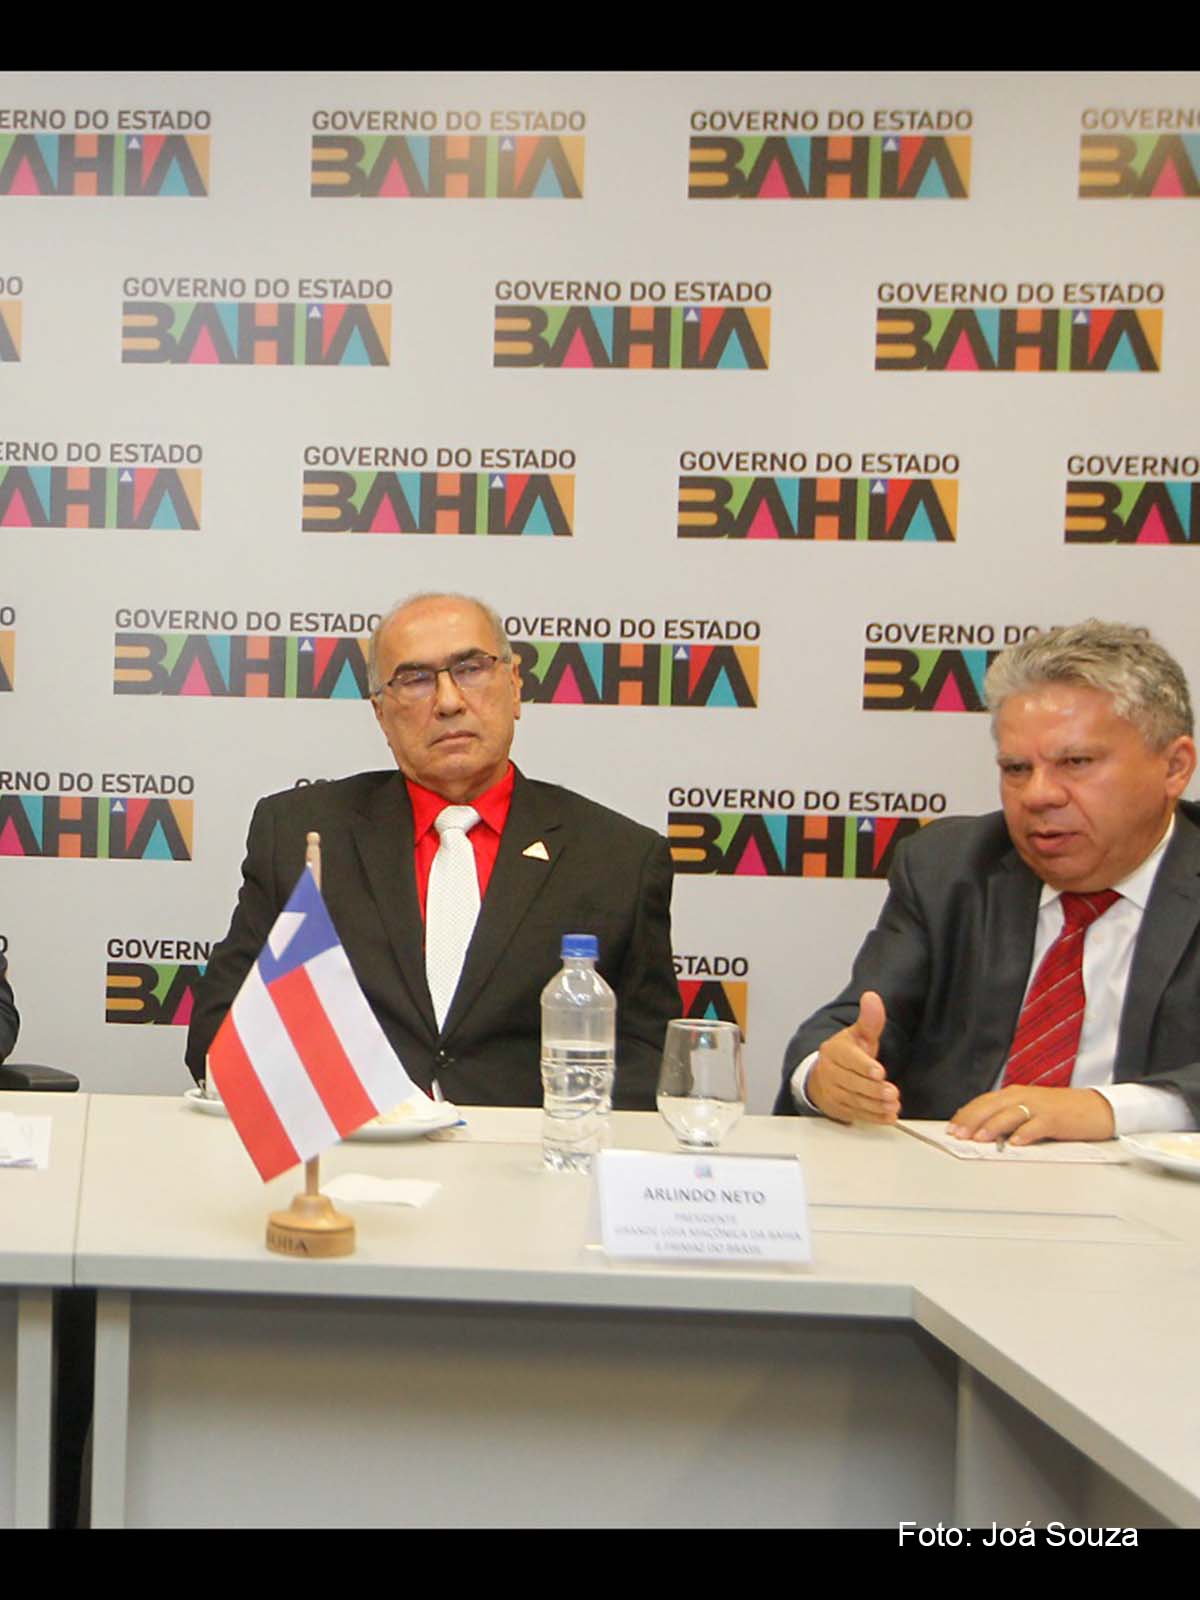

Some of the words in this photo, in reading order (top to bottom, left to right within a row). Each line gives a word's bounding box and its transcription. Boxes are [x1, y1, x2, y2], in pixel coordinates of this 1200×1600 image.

[75, 109, 109, 130] DO
[118, 110, 211, 130] ESTADO
[312, 110, 437, 130] GOVERNO
[446, 111, 480, 130] DO
[491, 111, 586, 131] ESTADO
[691, 110, 818, 131] GOVERNO
[828, 110, 864, 131] DO
[873, 110, 972, 130] ESTADO
[1081, 108, 1200, 130] GOVERN
[312, 136, 584, 198] BAHIA
[689, 135, 972, 200] BAHIA
[123, 277, 246, 298] GOVERNO
[255, 278, 290, 298] DO
[298, 278, 393, 299] ESTADO
[496, 281, 621, 301] GOVERNO
[630, 281, 666, 302] DO
[675, 282, 772, 302] ESTADO
[878, 283, 1007, 303] GOVERNO
[1017, 283, 1054, 303] DO
[1064, 283, 1164, 304] ESTADO
[123, 304, 391, 365] BAHIA
[495, 306, 770, 370] BAHIA
[876, 308, 1163, 373] BAHIA
[67, 443, 101, 462] DO
[110, 443, 202, 464] ESTADO
[304, 447, 428, 468] GOVERNO
[437, 448, 472, 468] DO
[480, 449, 576, 469] ESTADO
[680, 451, 807, 472] GOVERNO
[816, 453, 852, 472] DO
[861, 454, 959, 474] ESTADO
[1067, 455, 1200, 477] GOVERNO
[304, 472, 574, 535] BAHIA
[678, 477, 958, 541] BAHIA
[115, 609, 238, 631] GOVERNO
[246, 612, 281, 631] DO
[501, 617, 611, 638] OVERNO
[620, 619, 655, 639] DO
[665, 620, 760, 640] ESTADO
[866, 623, 995, 645] GOVERNO
[114, 633, 373, 700] BAHIA
[59, 772, 93, 792] DO
[102, 774, 194, 795] ESTADO
[668, 787, 795, 809] GOVERNO
[804, 791, 840, 810] DO
[849, 792, 946, 813] ESTADO
[107, 938, 209, 960] GOVERN
[672, 955, 749, 977] STADO
[644, 1186, 715, 1204] ARLINDO
[721, 1189, 767, 1206] NETO
